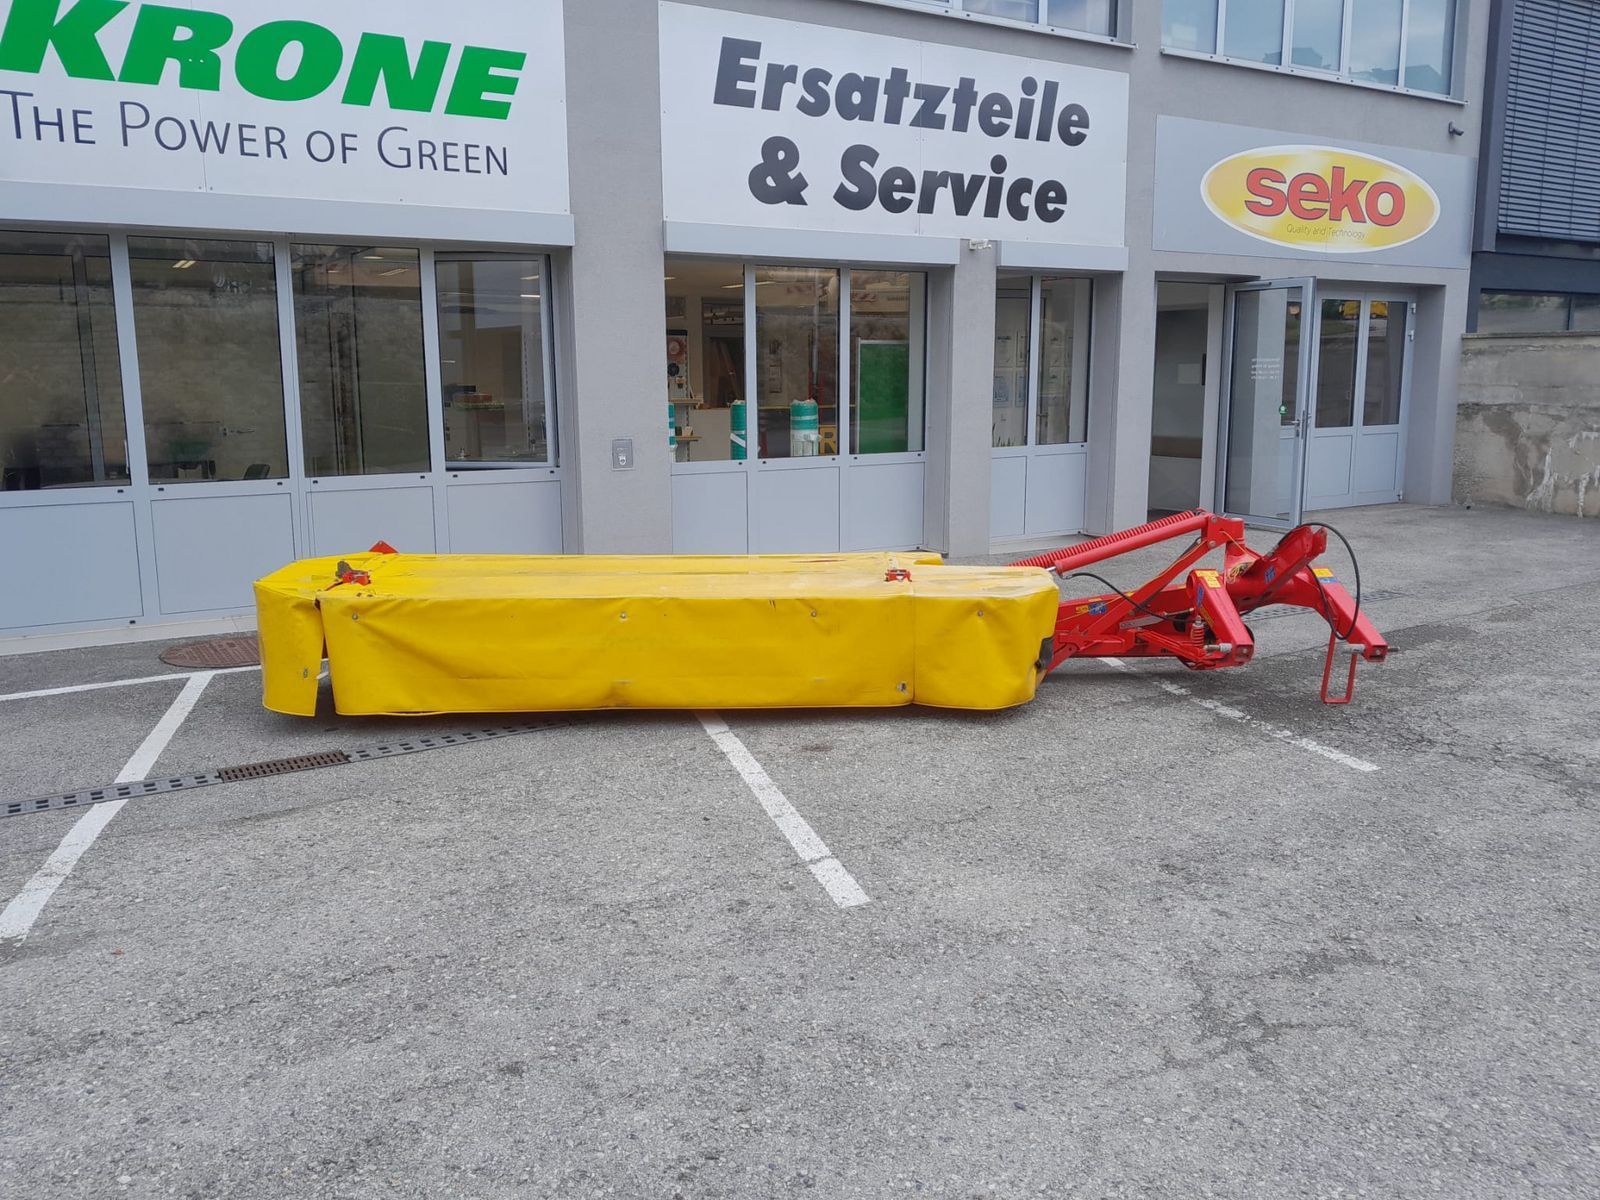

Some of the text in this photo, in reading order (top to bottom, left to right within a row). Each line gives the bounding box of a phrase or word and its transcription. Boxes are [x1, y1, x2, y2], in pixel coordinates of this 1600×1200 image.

[0, 0, 527, 120] KRONE
[713, 36, 1090, 147] Ersatzteile
[0, 90, 508, 176] THE POWER OF GREEN
[748, 136, 1068, 224] & Service
[1244, 166, 1406, 227] seko
[1286, 223, 1366, 241] Quality and Technology
